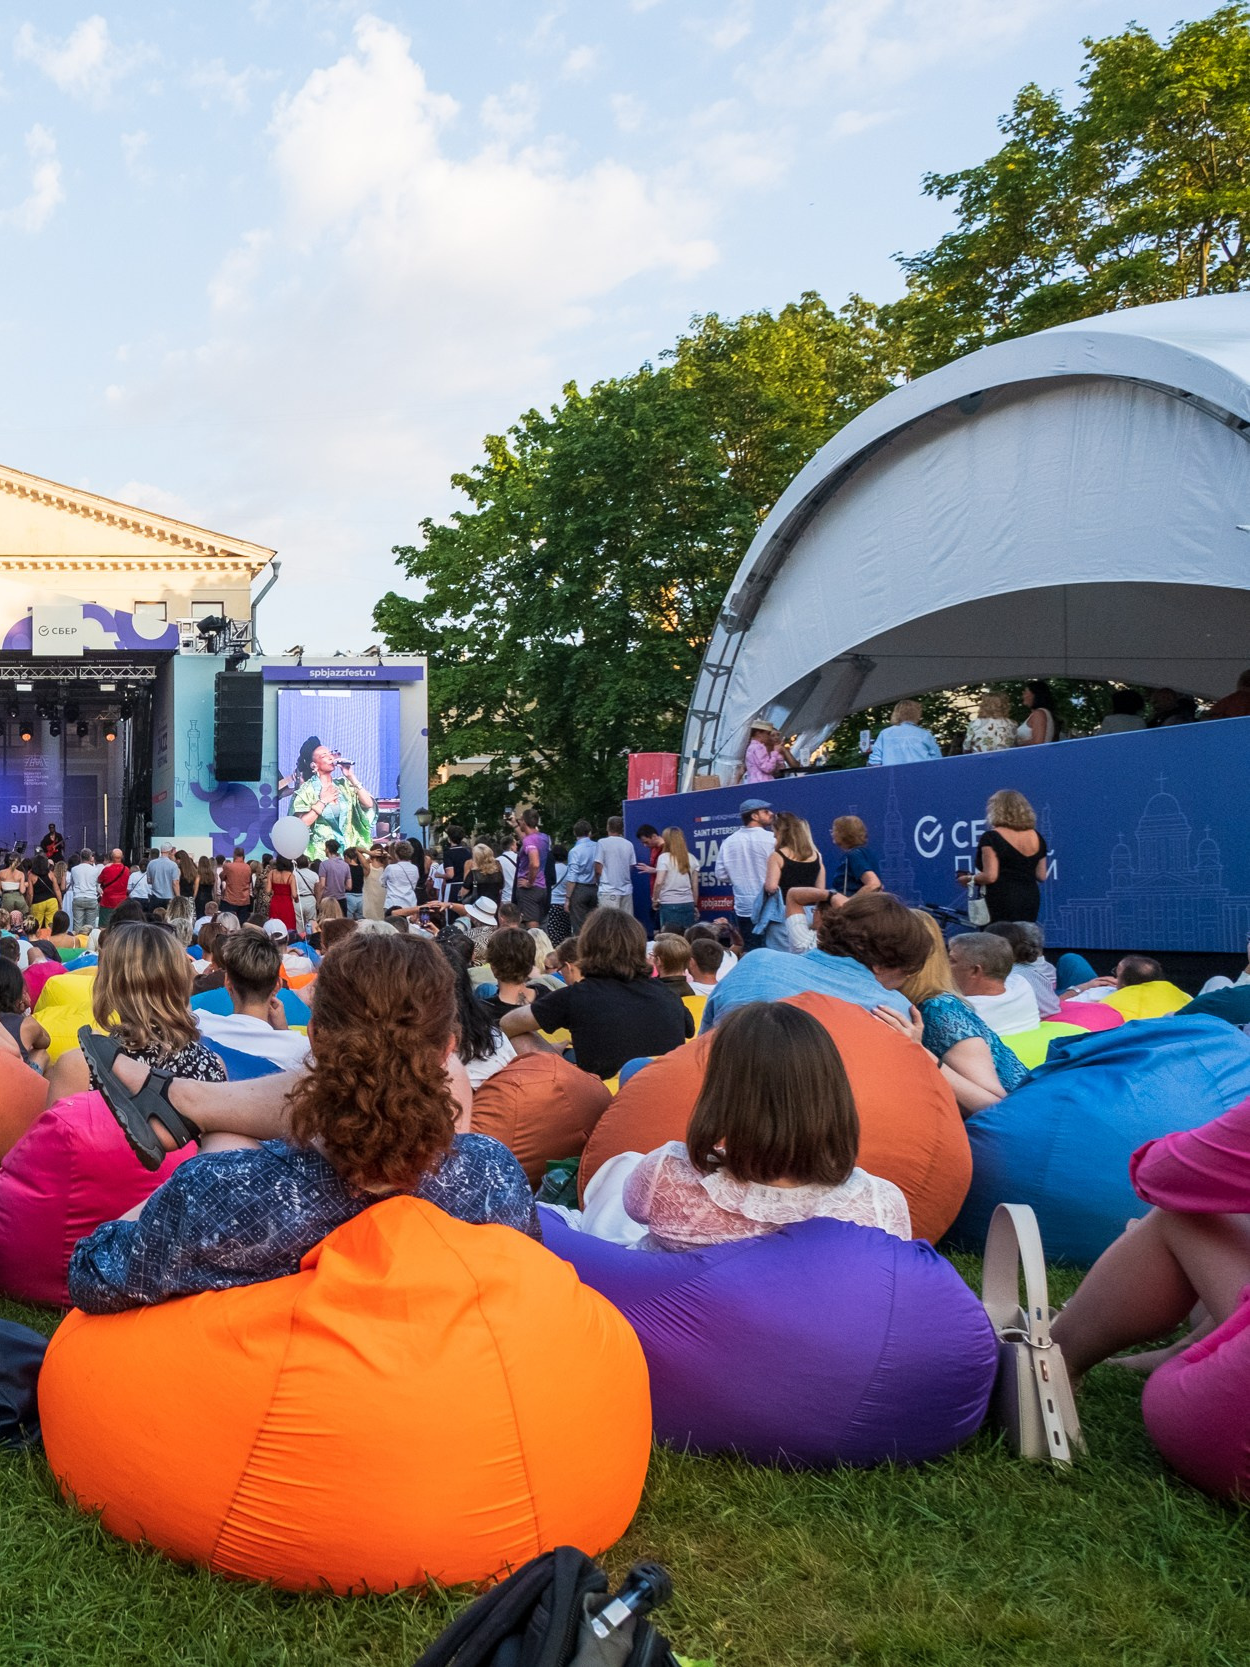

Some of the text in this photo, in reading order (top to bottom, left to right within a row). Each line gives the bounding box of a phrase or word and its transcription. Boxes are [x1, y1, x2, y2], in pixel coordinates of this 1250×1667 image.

[51, 627, 78, 635] СБЕР
[309, 667, 376, 678] spbjazzfest.ru
[693, 828, 710, 837] SAINT
[695, 839, 721, 868] JA
